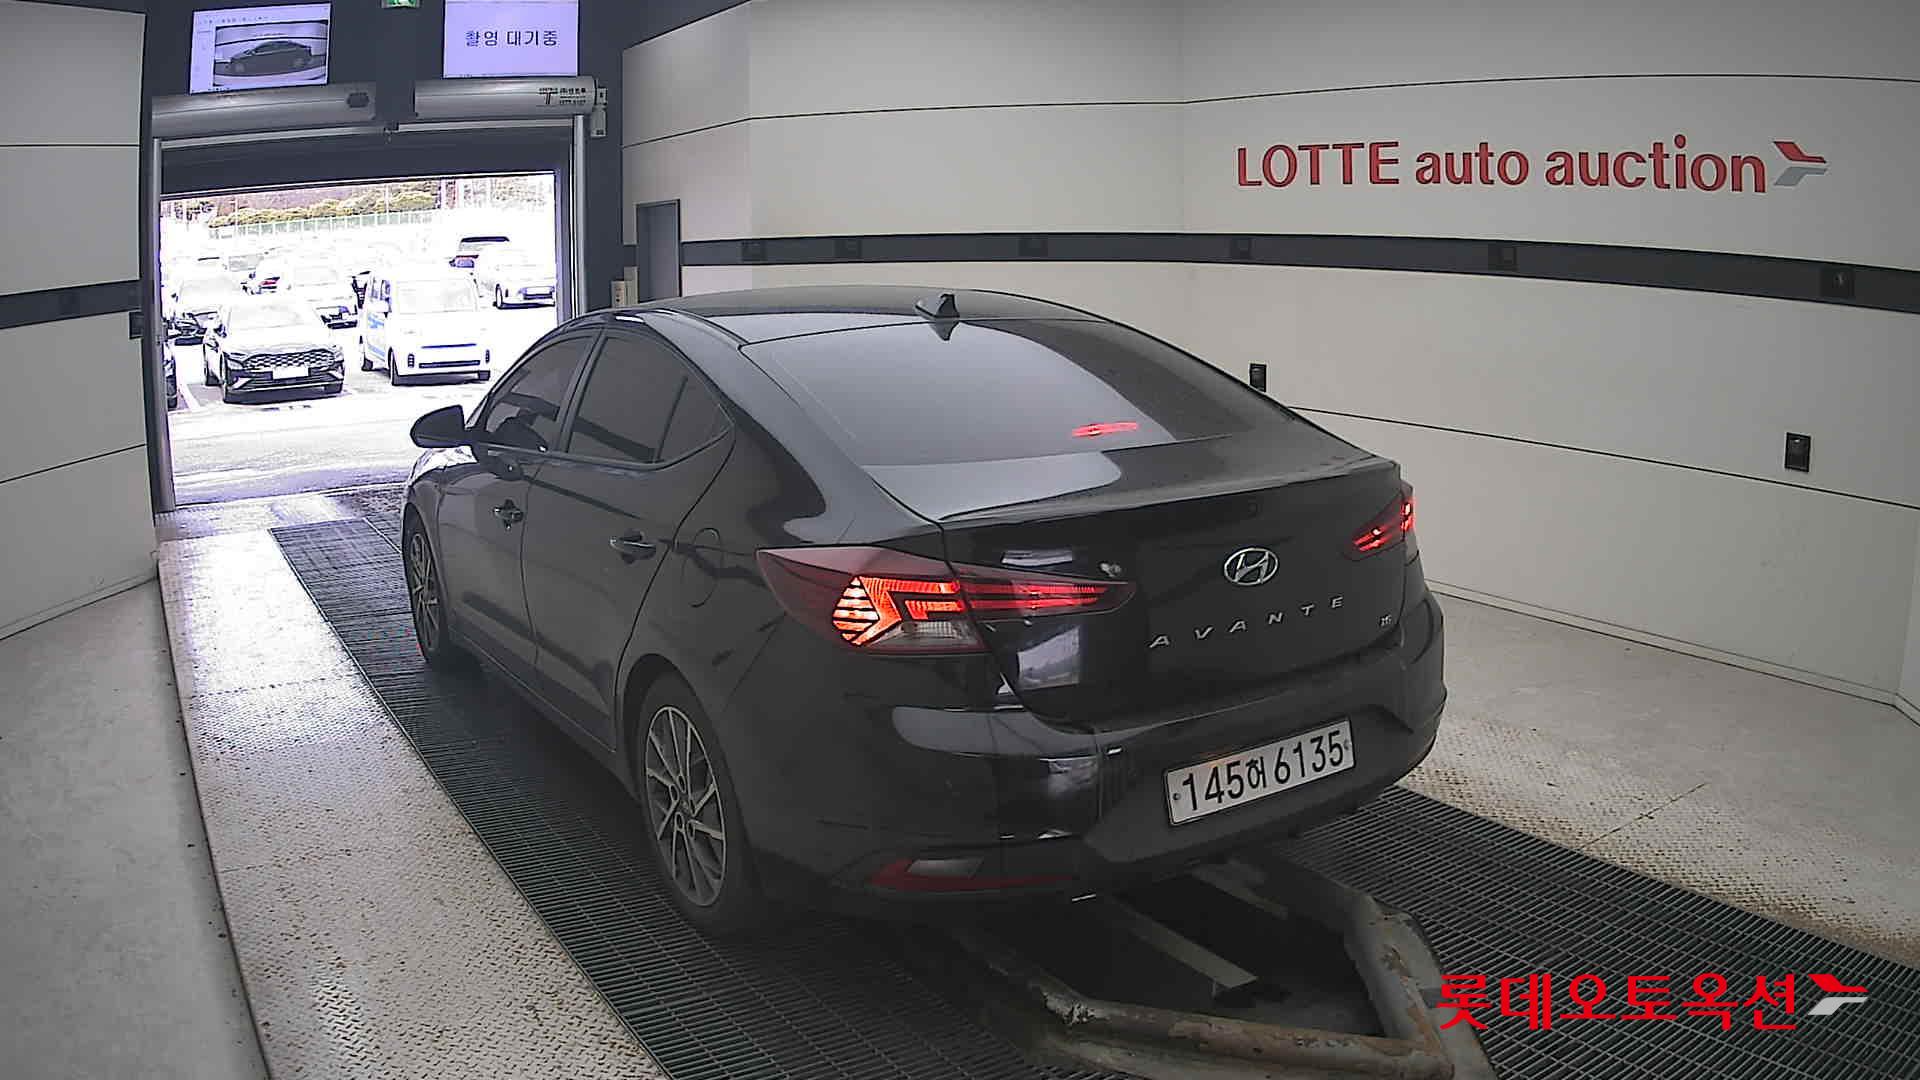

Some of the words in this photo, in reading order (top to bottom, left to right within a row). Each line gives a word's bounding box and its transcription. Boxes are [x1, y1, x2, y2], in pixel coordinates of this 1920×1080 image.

[506, 30, 558, 47] 대기중
[1237, 141, 1399, 187] LOTTE
[1415, 141, 1529, 186] auto
[1545, 134, 1767, 193] auction
[1149, 596, 1344, 648] AVANTE
